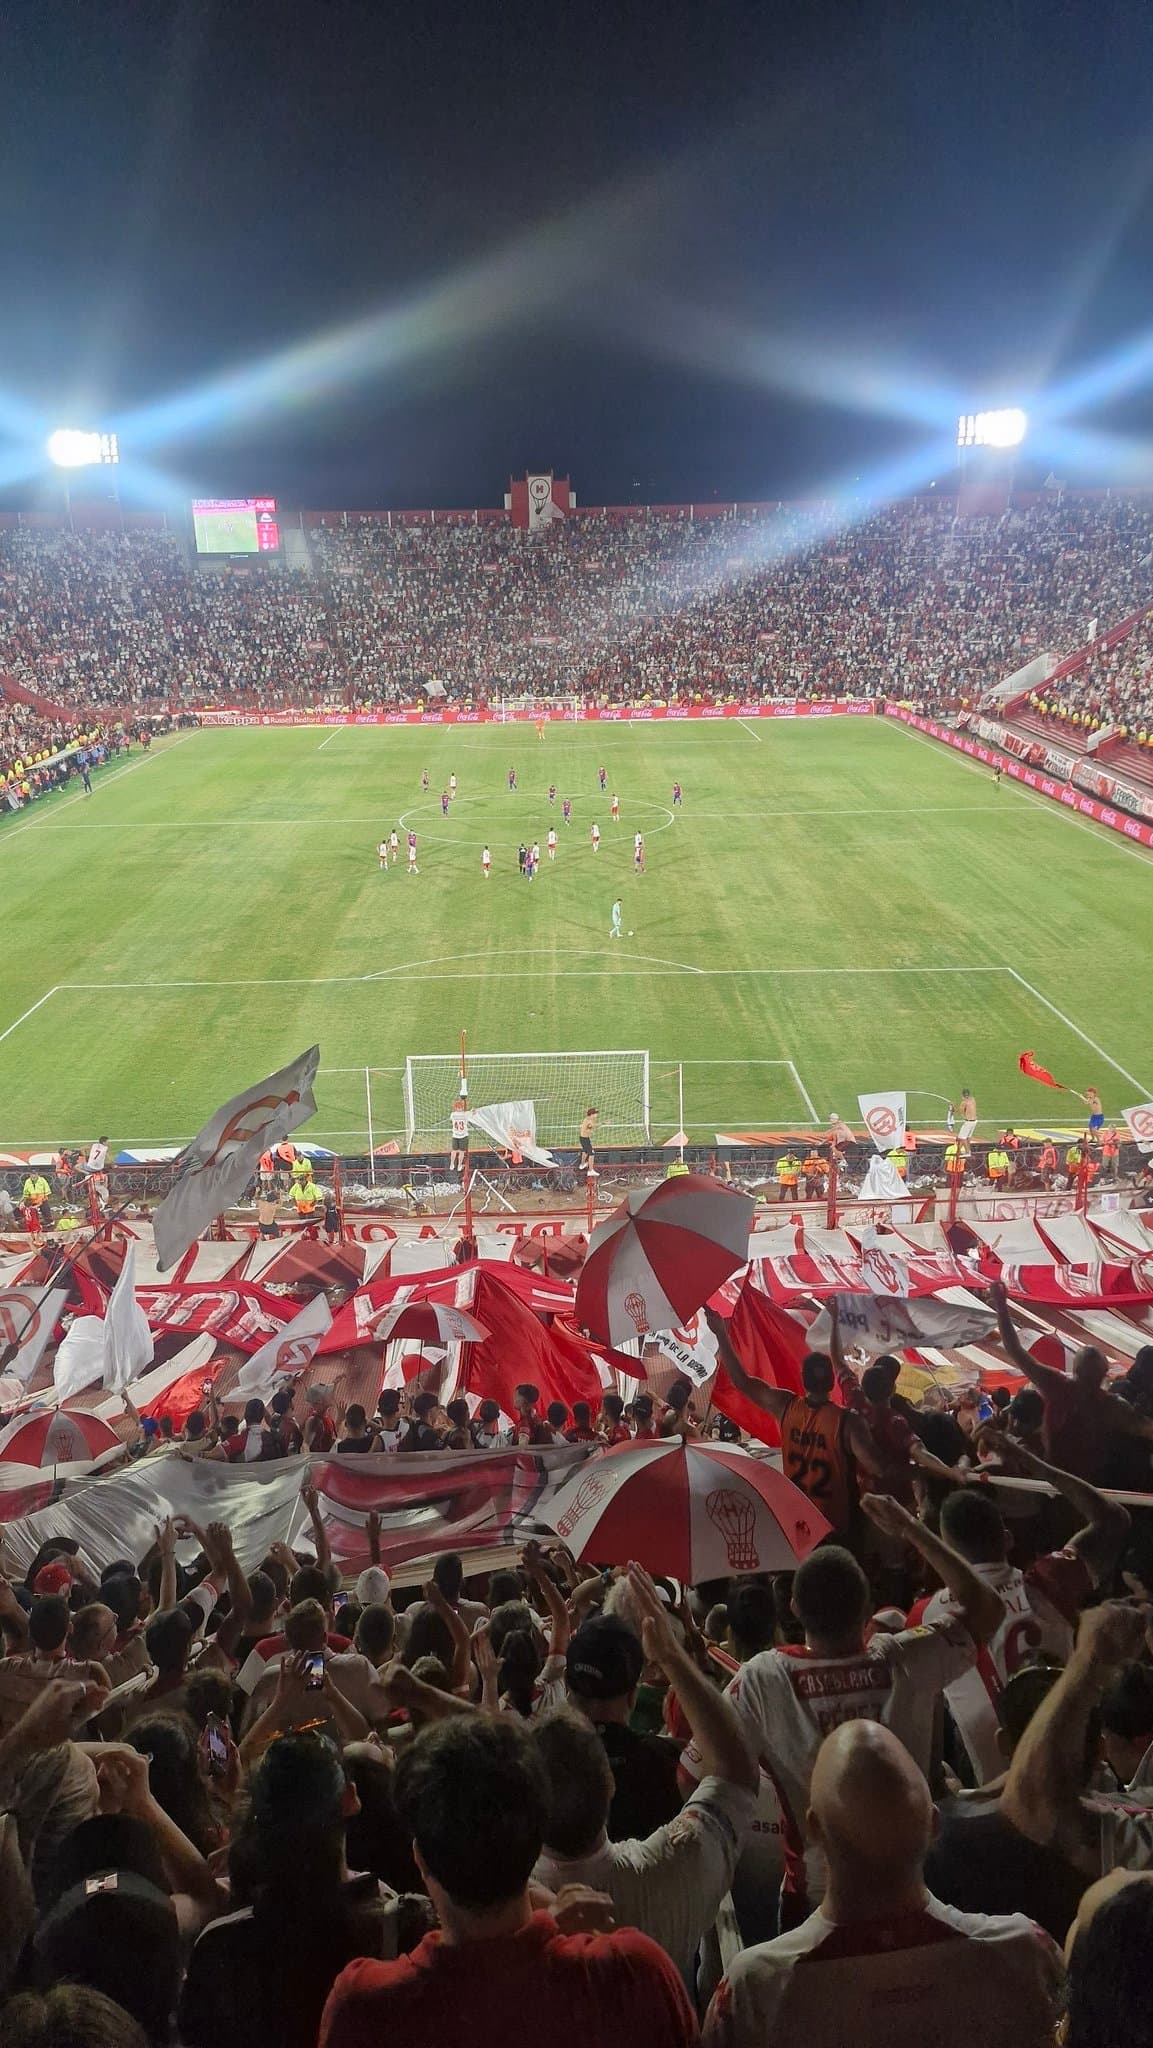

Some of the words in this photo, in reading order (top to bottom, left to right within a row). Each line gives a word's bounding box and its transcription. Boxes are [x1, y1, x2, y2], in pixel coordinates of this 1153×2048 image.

[218, 715, 260, 726] Kappa
[270, 716, 293, 724] Russell
[294, 716, 321, 724] Bedford
[454, 1120, 465, 1131] 43
[93, 1149, 102, 1161] 7
[676, 1350, 690, 1364] LA
[788, 1451, 833, 1499] 22
[798, 1667, 874, 1695] CASABLANC
